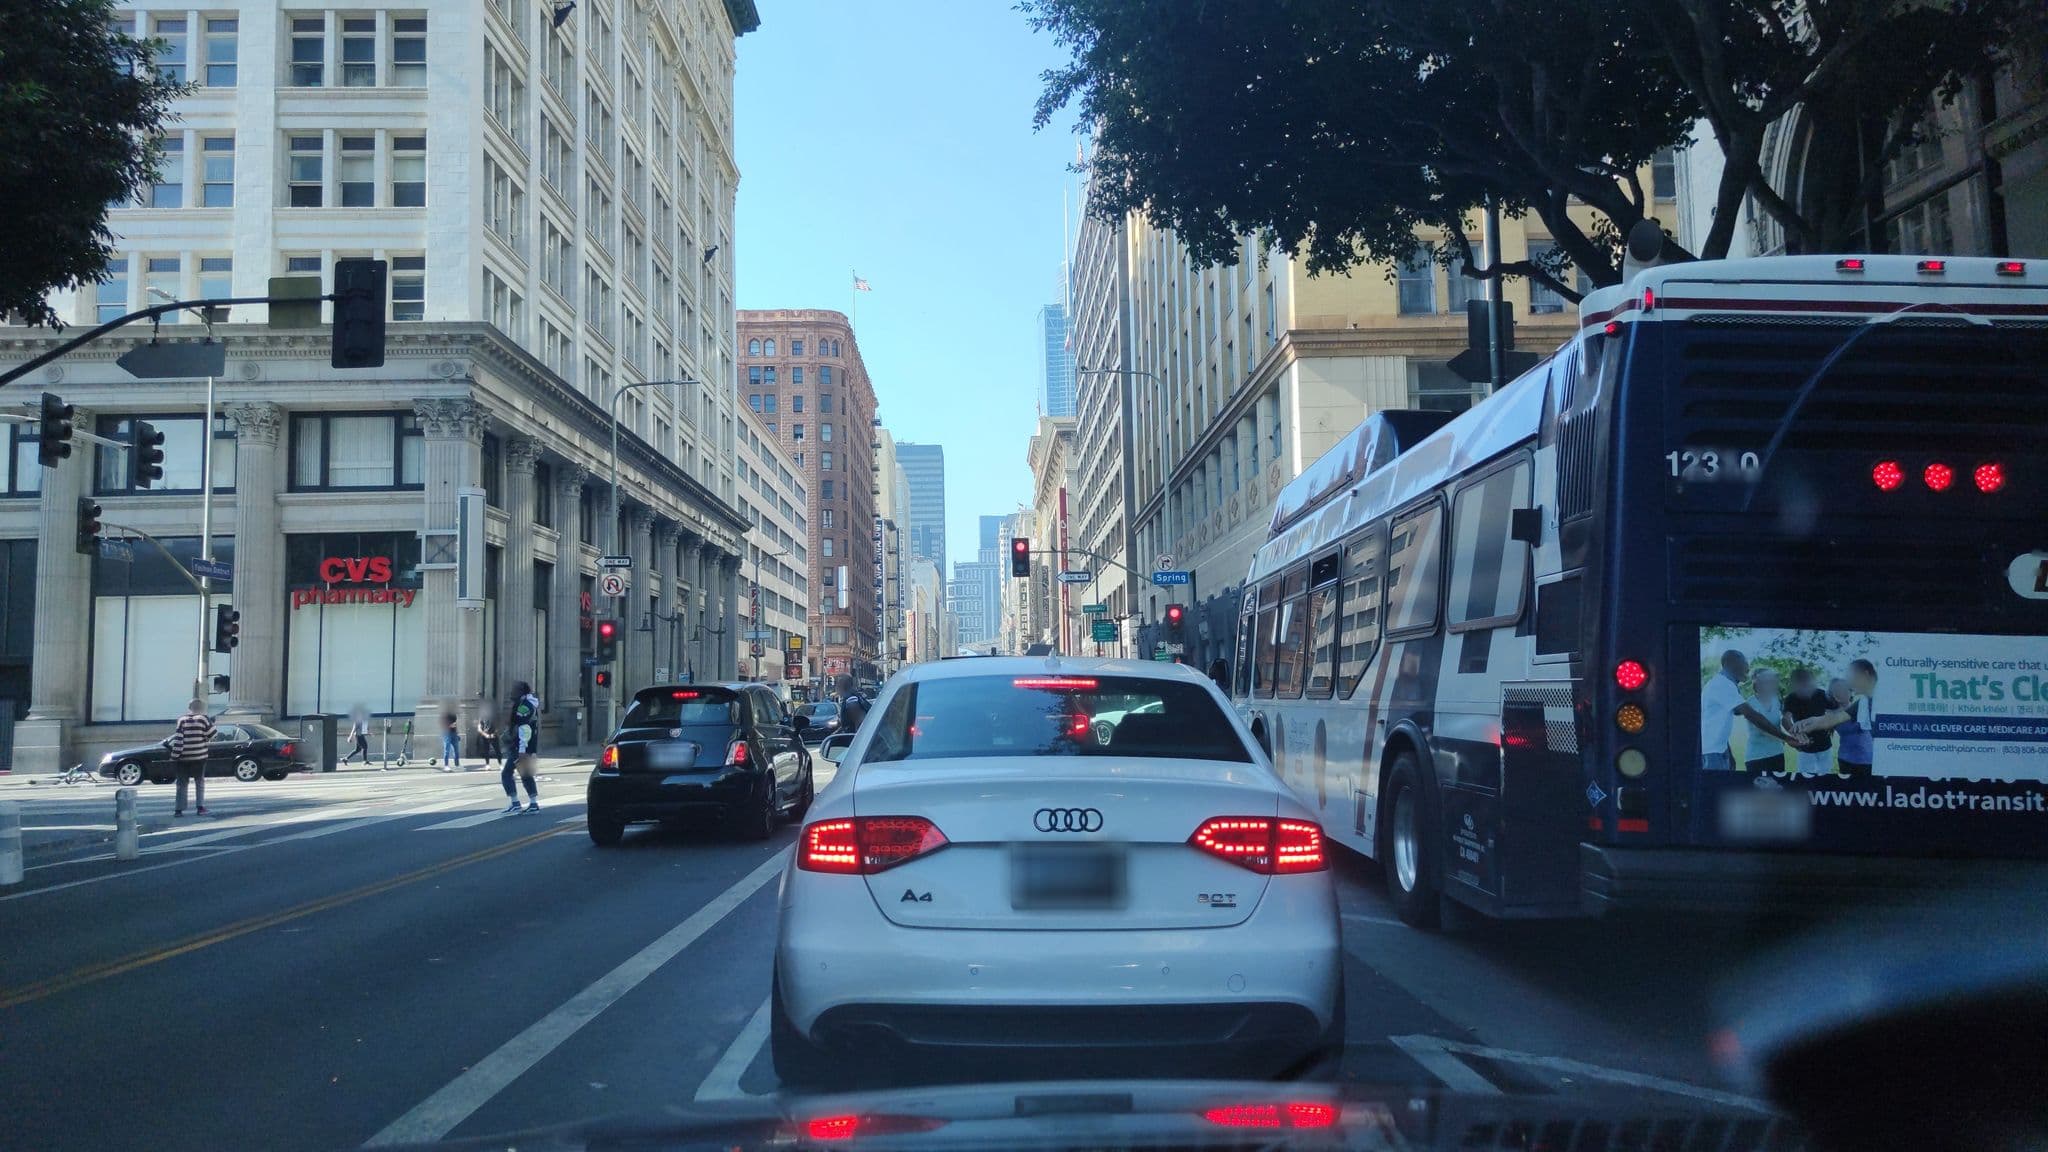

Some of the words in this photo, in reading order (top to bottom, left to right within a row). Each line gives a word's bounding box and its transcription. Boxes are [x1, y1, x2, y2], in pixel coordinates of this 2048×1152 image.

[1666, 450, 1759, 477] 1230
[320, 557, 392, 583] CVS
[1156, 573, 1186, 583] Spring
[293, 585, 417, 610] pharmacy
[1885, 656, 1990, 671] Culturally-sensitive
[1991, 661, 2016, 670] care
[2018, 660, 2041, 670] that
[1909, 672, 2004, 700] That's
[1878, 722, 1911, 732] ENROLL
[1912, 723, 1921, 732] IN
[1922, 723, 1930, 732] A
[1930, 723, 1962, 733] CLEVER
[1963, 724, 1987, 734] CARE
[1988, 725, 2033, 735] MEDICARE
[901, 889, 933, 902] A4
